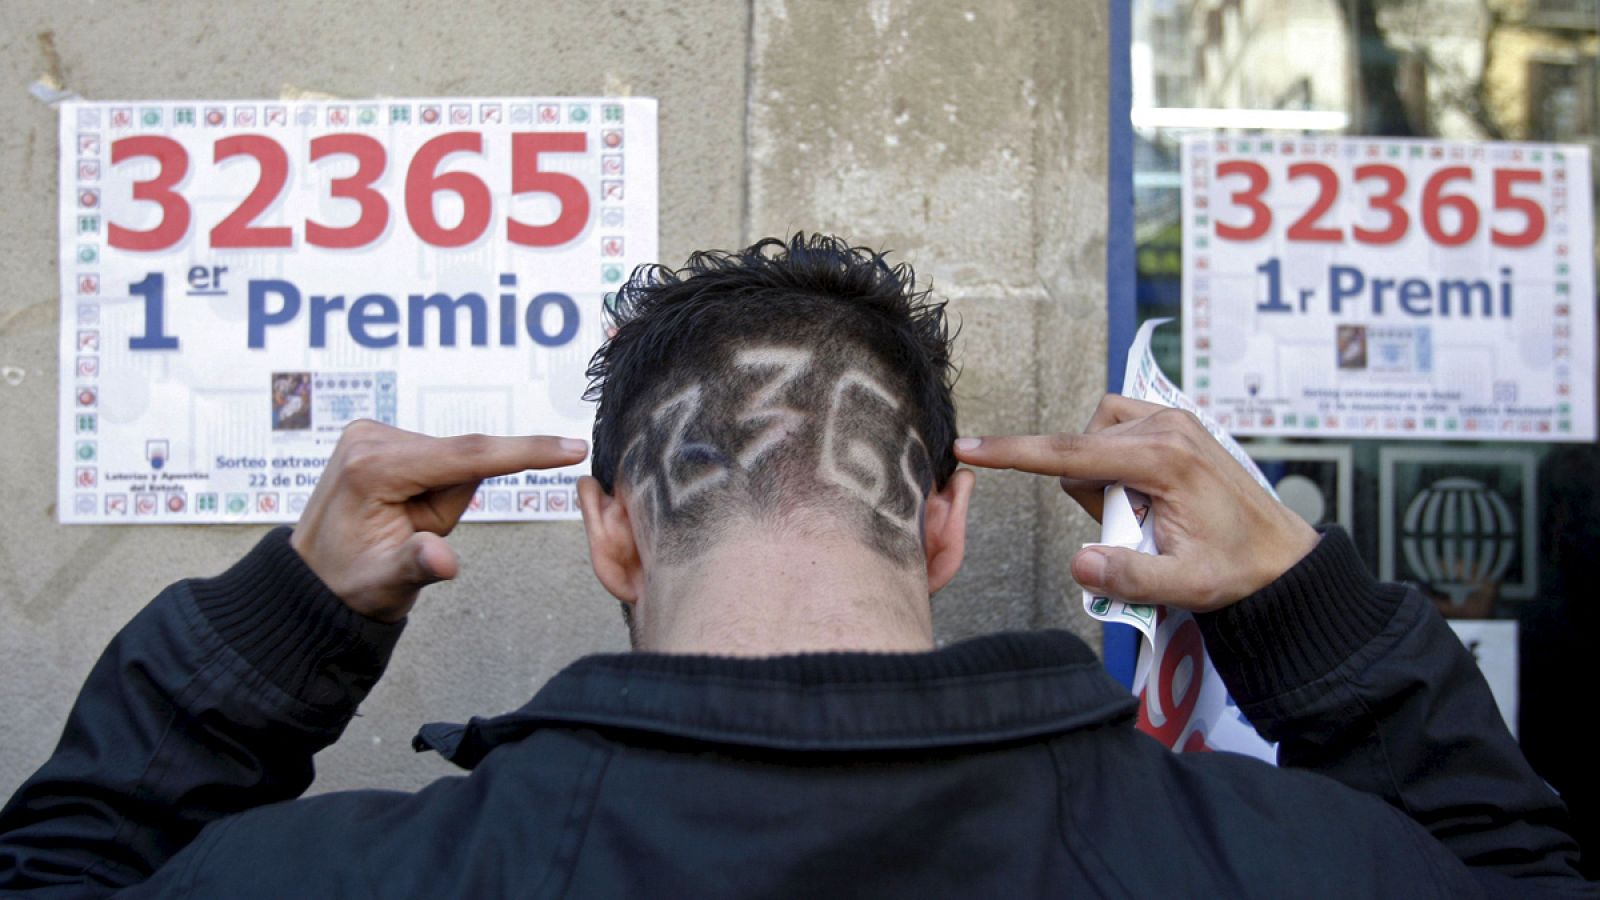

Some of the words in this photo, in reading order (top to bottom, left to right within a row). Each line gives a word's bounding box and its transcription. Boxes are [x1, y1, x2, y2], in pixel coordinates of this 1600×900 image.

[106, 131, 592, 251] 32365
[1214, 160, 1547, 249] 32365
[247, 274, 581, 350] Premio
[1327, 265, 1513, 319] Premi
[215, 456, 267, 469] Sorteo
[271, 456, 328, 469] extraor
[249, 473, 267, 487] 22
[271, 473, 291, 487] de
[295, 473, 322, 487] Dic
[525, 473, 580, 486] Nacio
